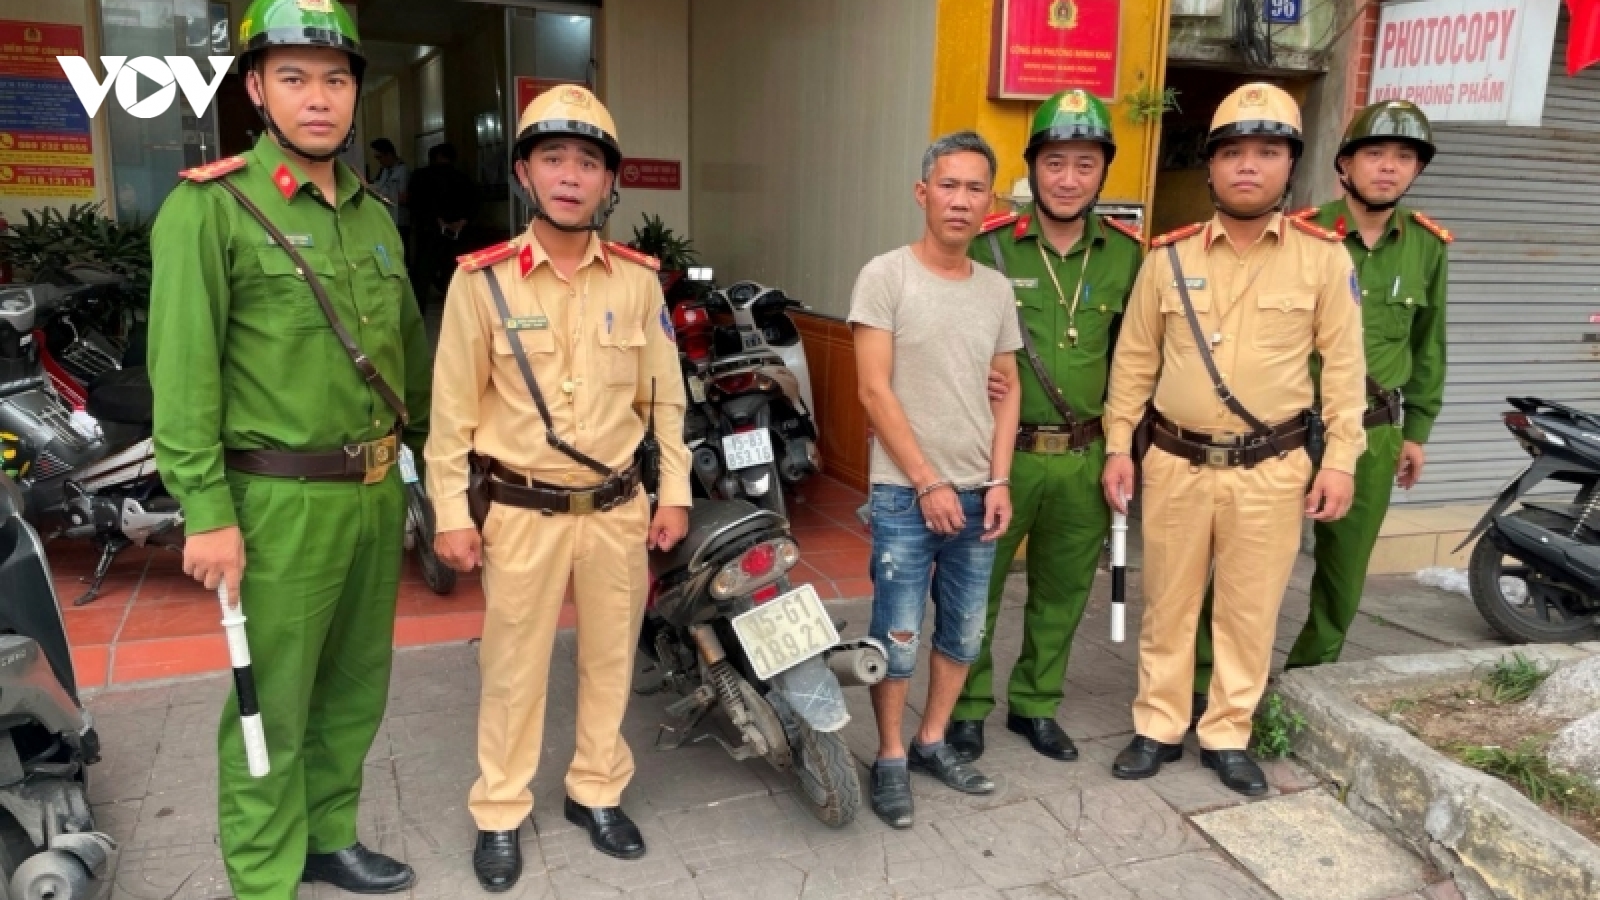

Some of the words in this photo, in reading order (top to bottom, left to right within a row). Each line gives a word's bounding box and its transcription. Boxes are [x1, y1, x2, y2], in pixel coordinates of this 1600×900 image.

[1009, 44, 1031, 55] CÔNG
[1379, 9, 1516, 69] PHOTOCOPY
[754, 616, 831, 671] 189.21
